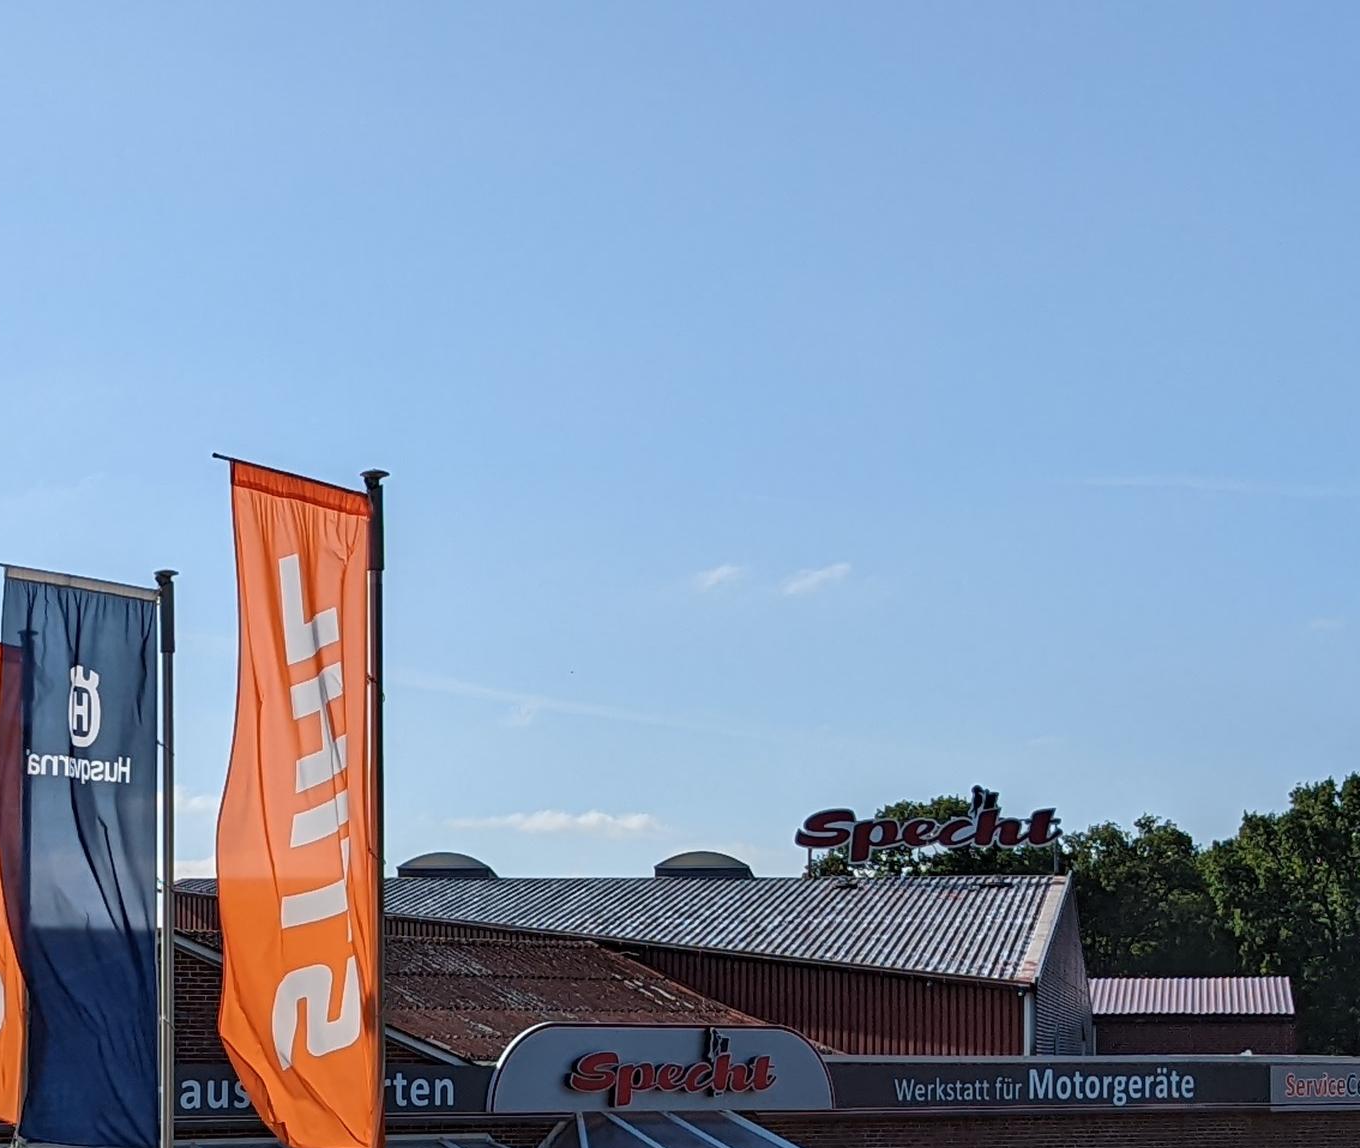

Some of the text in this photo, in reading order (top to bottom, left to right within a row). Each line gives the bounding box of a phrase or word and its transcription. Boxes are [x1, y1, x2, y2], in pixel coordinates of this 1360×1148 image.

[795, 807, 1063, 865] Specht
[179, 1079, 250, 1110] aus
[570, 1052, 777, 1107] Specht
[894, 1067, 1195, 1106] Werkstatt für Motorgeräte
